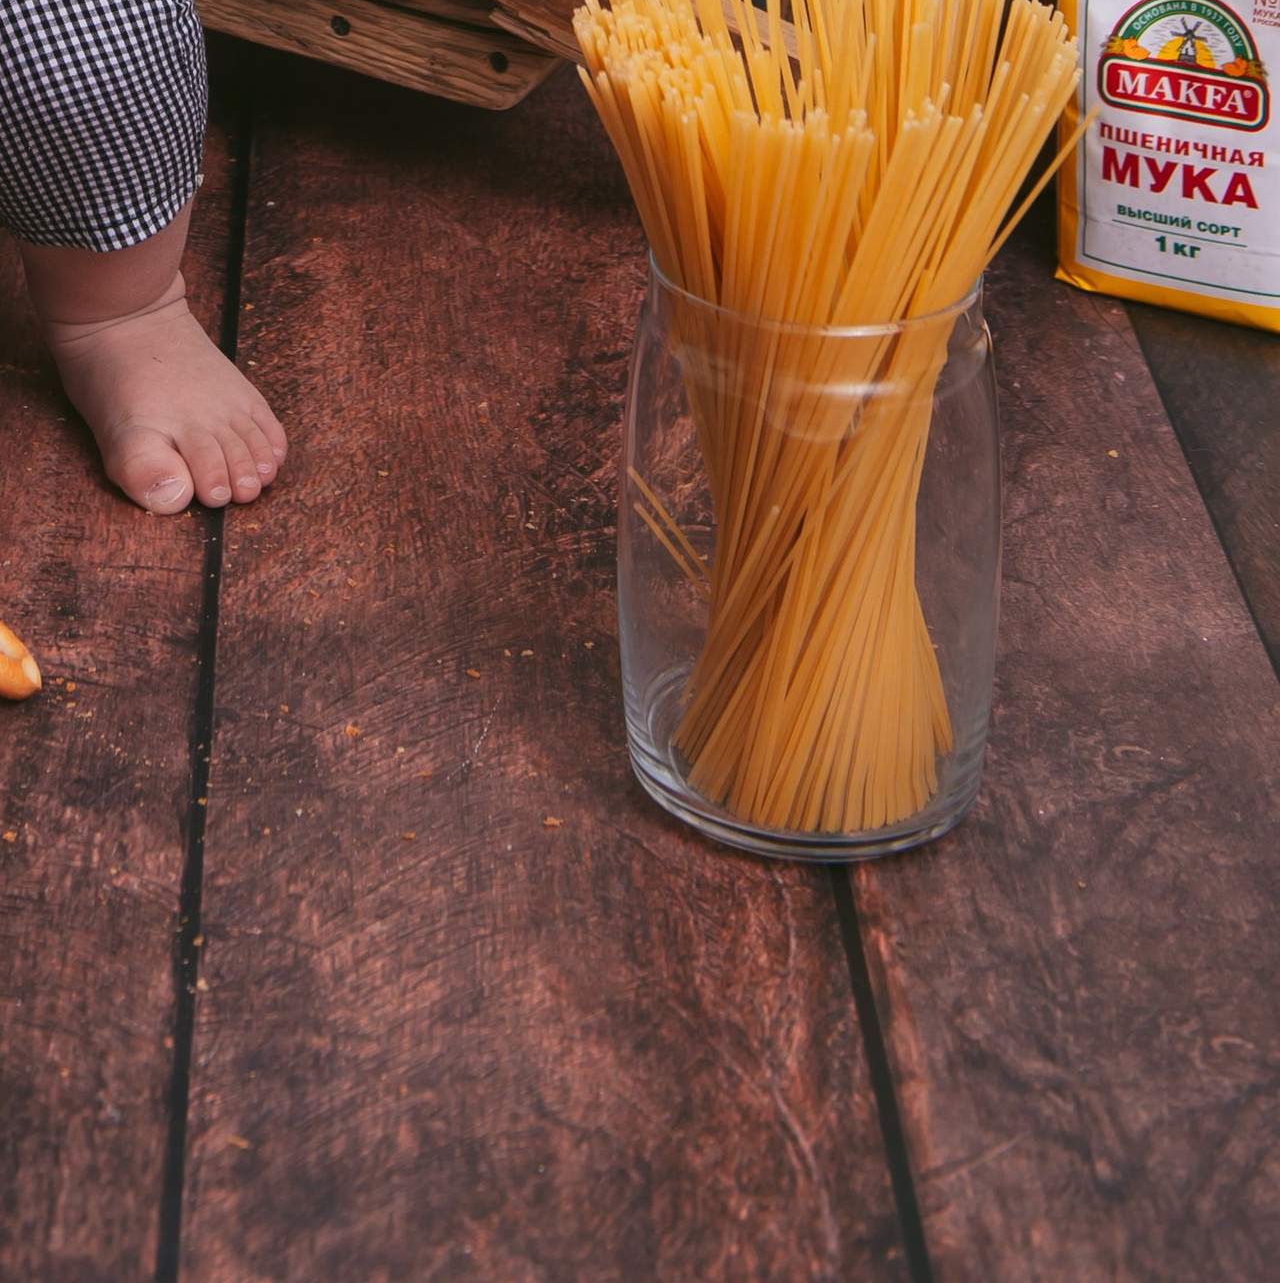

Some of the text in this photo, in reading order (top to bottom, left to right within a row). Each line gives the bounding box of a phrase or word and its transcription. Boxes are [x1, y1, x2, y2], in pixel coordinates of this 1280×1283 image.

[1132, 1, 1244, 48] ОСНОВАНА В 1937 ГОДУ
[1116, 69, 1248, 115] MAKFA
[1100, 122, 1265, 168] ПШЕНИЧНАЯ
[1102, 145, 1260, 210] МУКА
[1117, 204, 1242, 238] ВЫСШИЙ СОРТ
[1155, 235, 1201, 258] 1 кг
